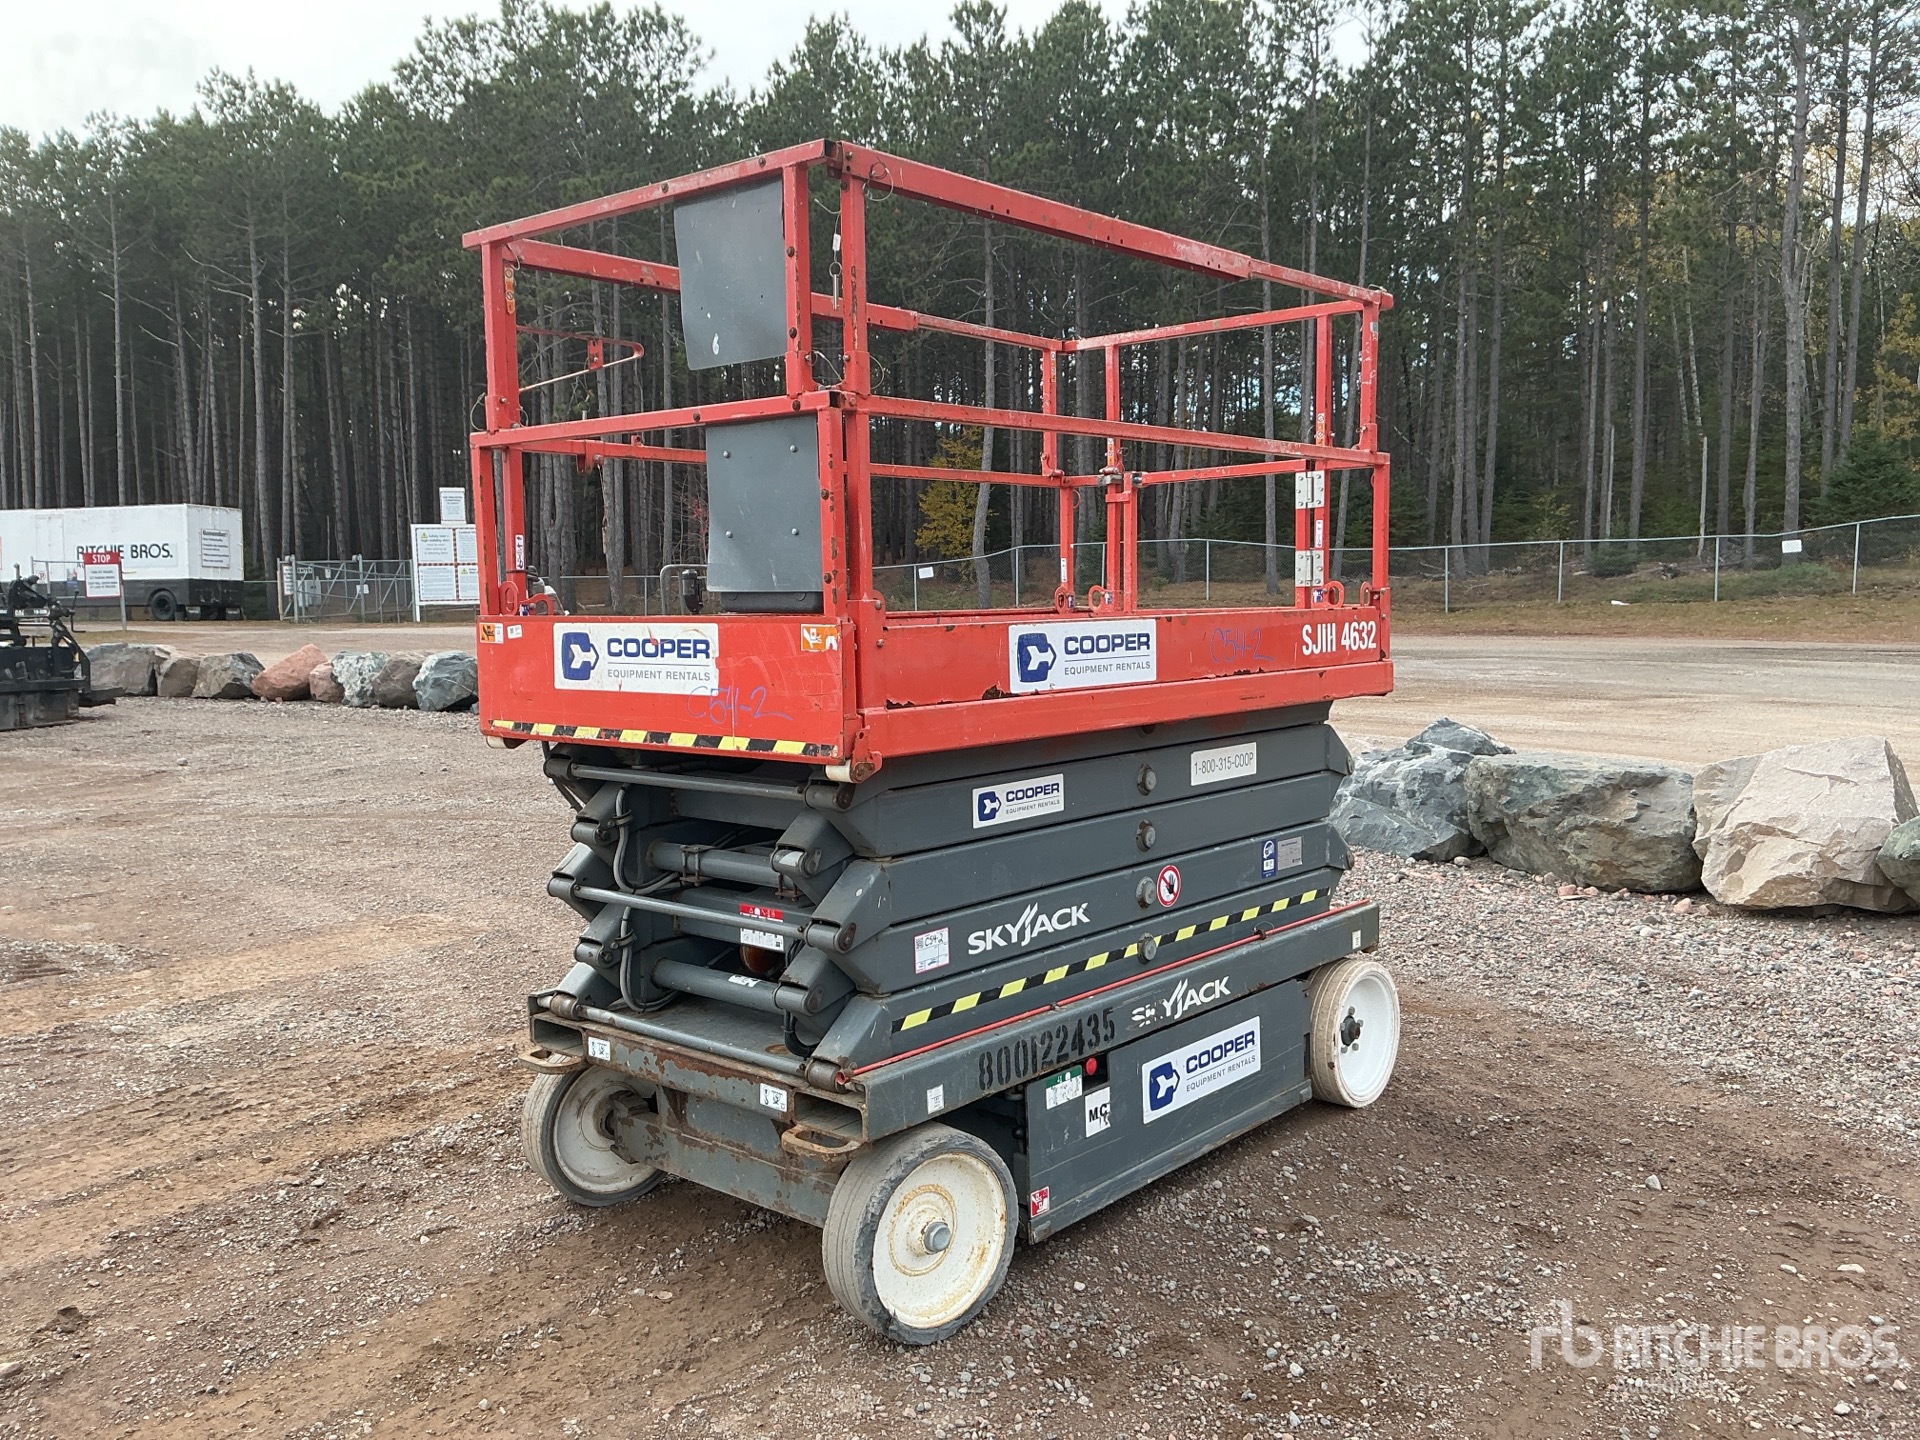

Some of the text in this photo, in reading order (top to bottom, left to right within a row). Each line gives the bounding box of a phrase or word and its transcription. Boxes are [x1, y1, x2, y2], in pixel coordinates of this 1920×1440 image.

[92, 554, 111, 563] STOP
[130, 543, 173, 558] BROS.
[1064, 633, 1150, 655] COOPER
[1341, 620, 1377, 651] 4632
[607, 638, 710, 659] COOPER
[607, 669, 711, 681] EQUIPMENT RENTALS
[1064, 661, 1151, 676] EQUIPMENT RENTALS
[1194, 752, 1254, 775] 1-800-315-COOP
[1006, 783, 1060, 802] COOPER
[1006, 800, 1060, 815] EQUIPMENT RENTALS
[967, 902, 1091, 955] SKYJACK
[978, 1006, 1115, 1091] 800122435
[1186, 1030, 1255, 1074] COOPER
[1186, 1055, 1256, 1092] EQUIPMENT RENTALS
